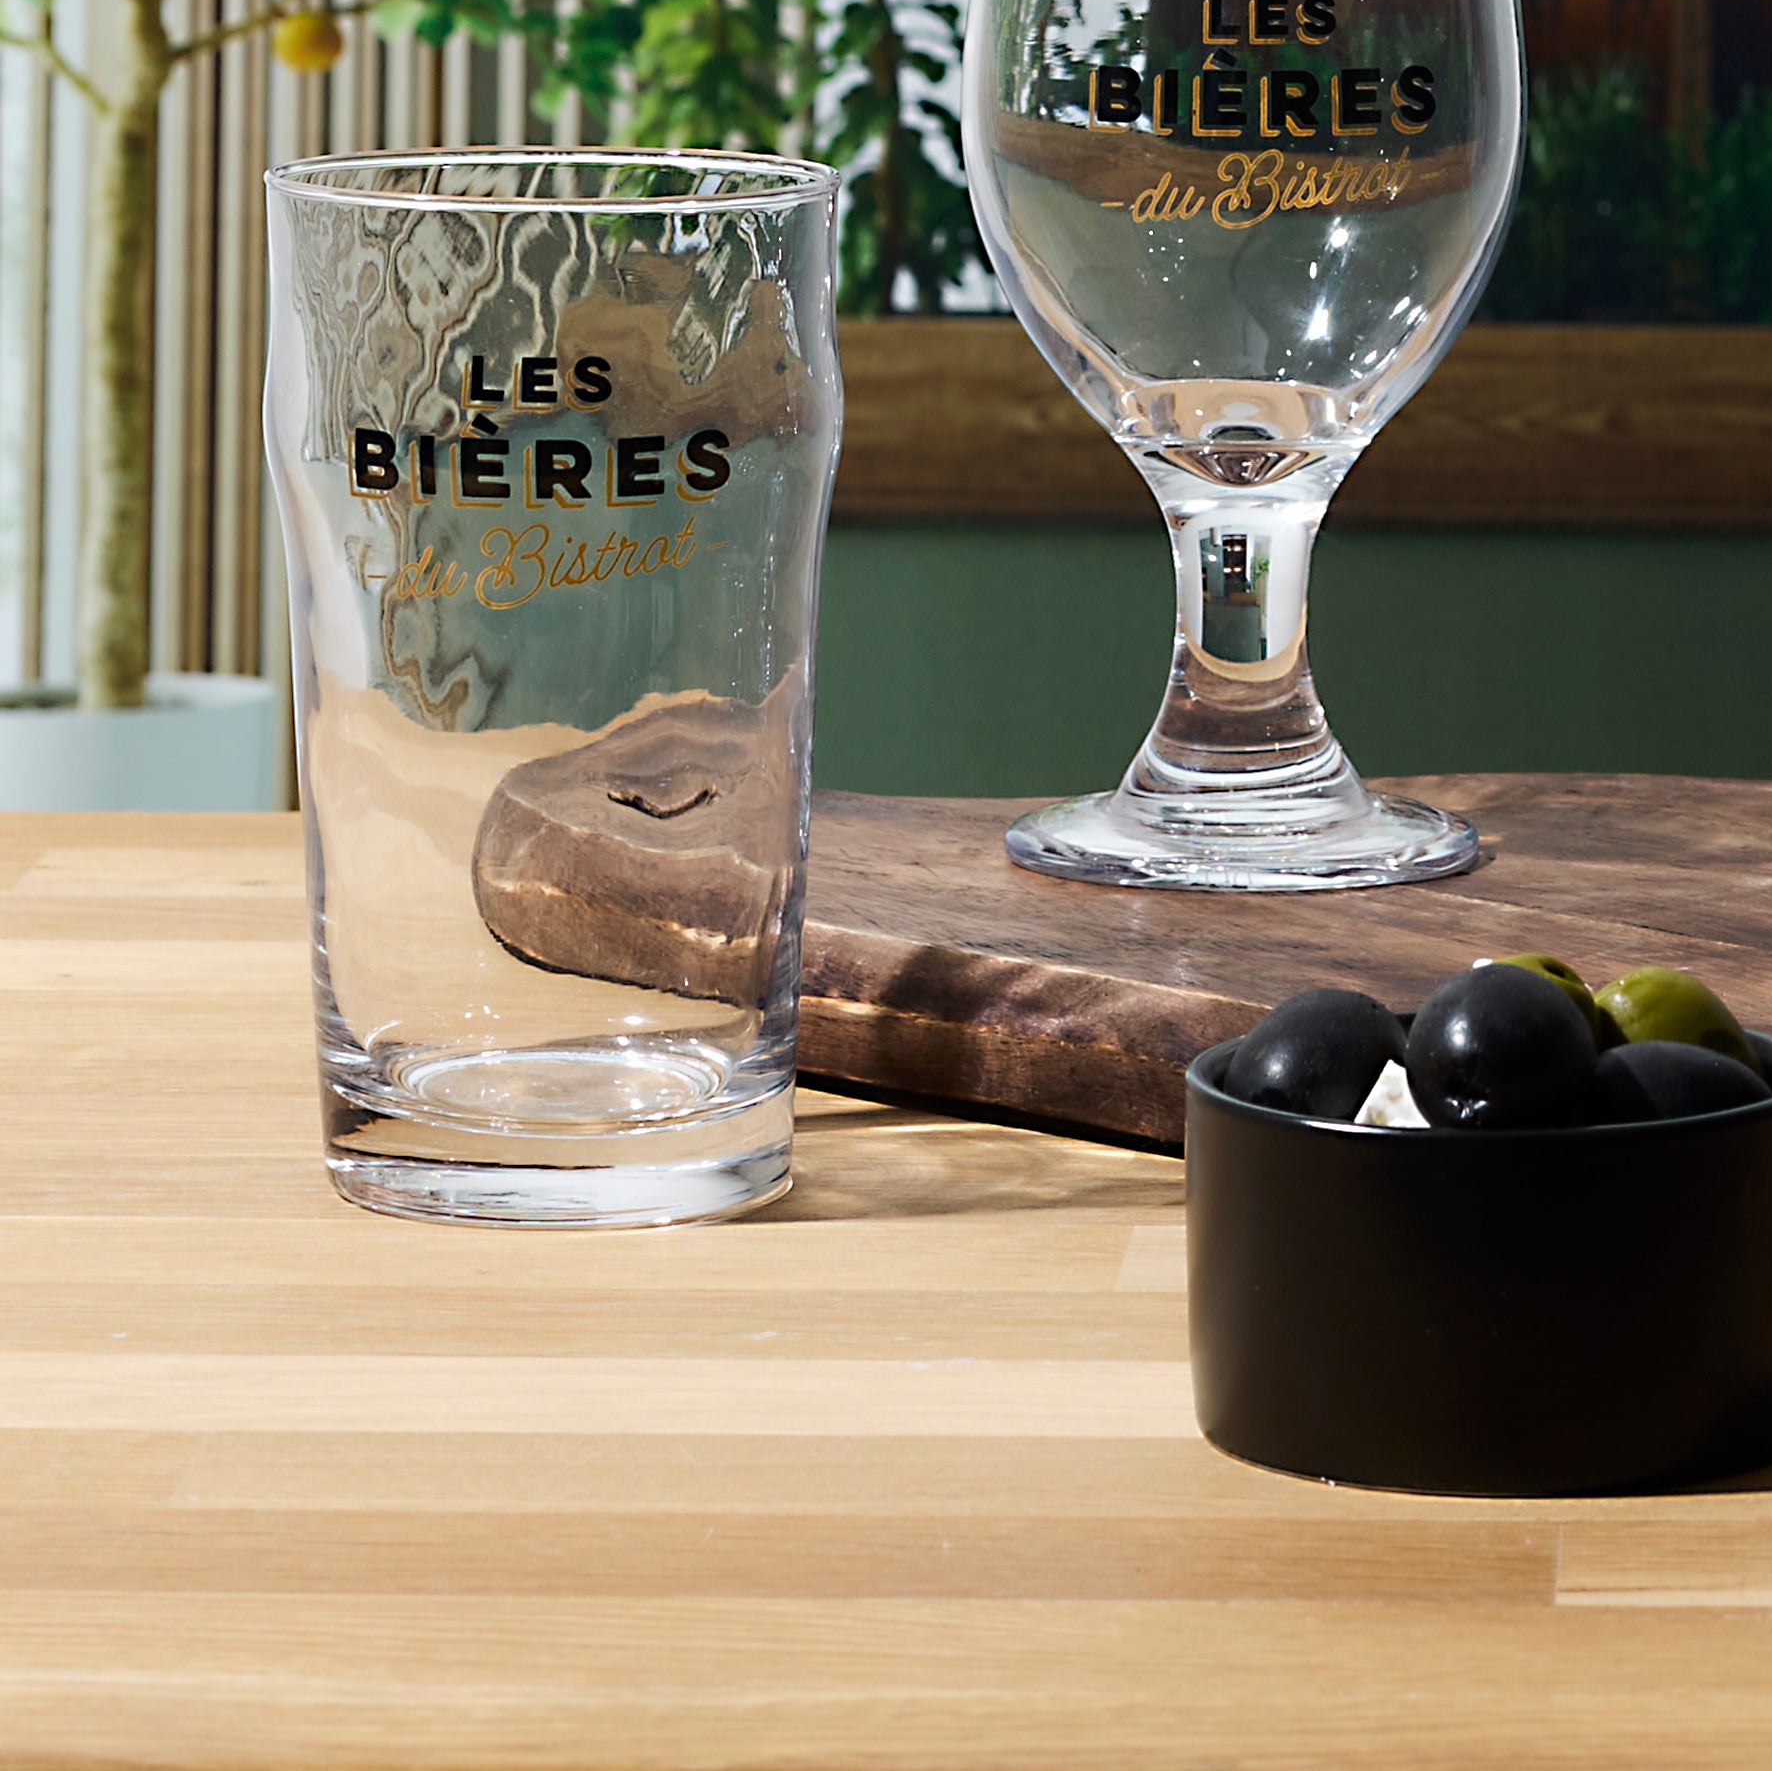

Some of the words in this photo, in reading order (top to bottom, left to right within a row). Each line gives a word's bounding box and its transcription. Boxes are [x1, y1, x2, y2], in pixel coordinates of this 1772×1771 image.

[1088, 47, 1437, 138] BIÈRES
[461, 355, 613, 412] LES
[348, 412, 731, 509] BIÈRES
